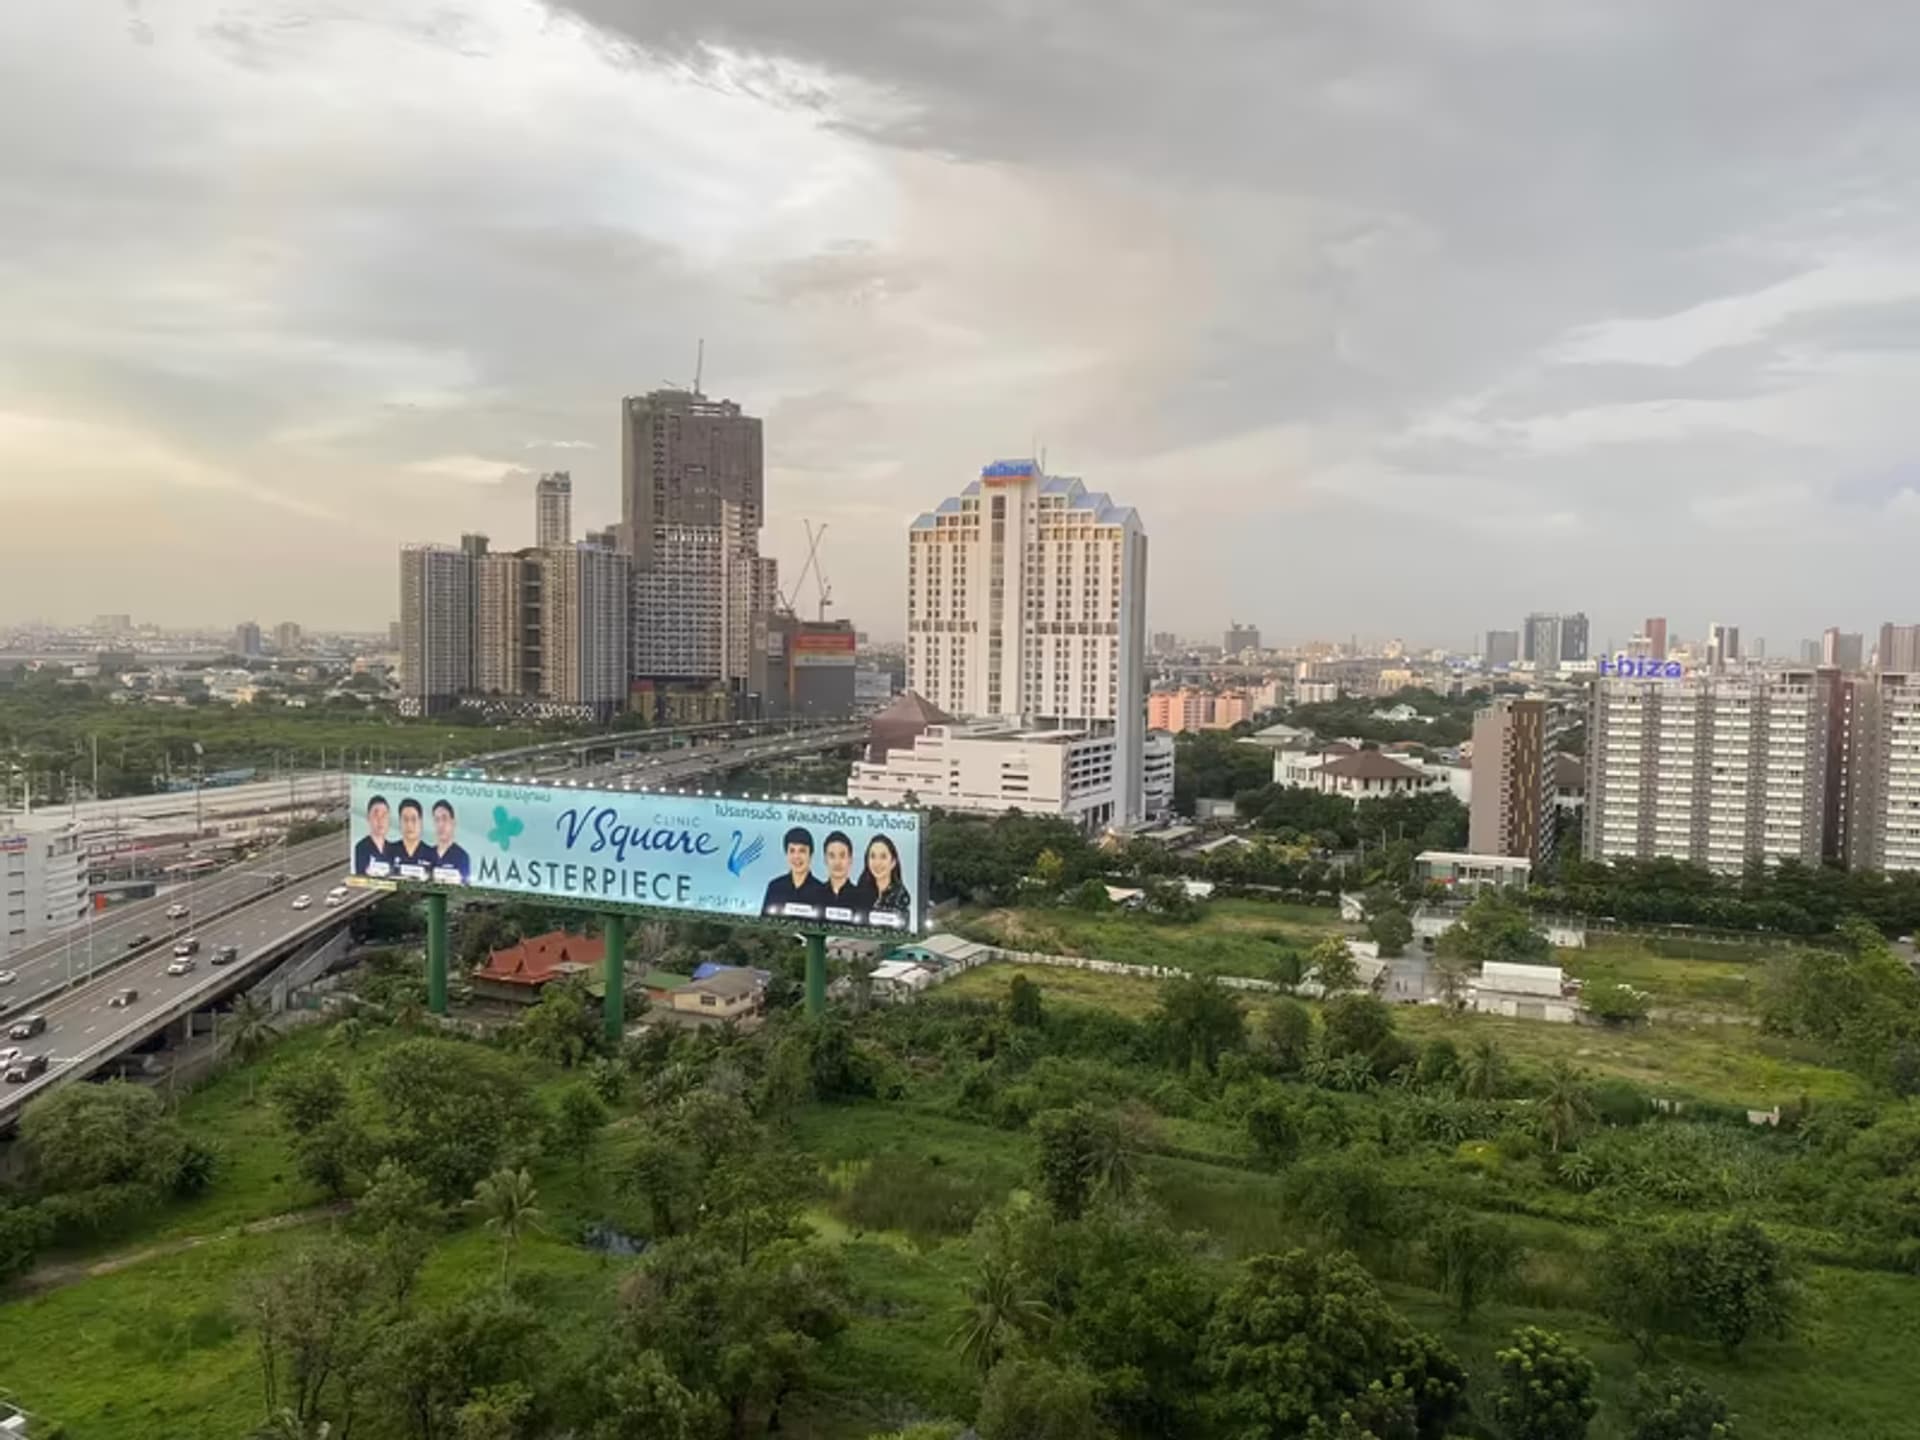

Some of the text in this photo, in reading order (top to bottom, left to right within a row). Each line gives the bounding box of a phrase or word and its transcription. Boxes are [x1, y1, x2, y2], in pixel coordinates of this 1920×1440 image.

[1600, 653, 1682, 678] i-biza
[653, 814, 701, 828] CLINIC
[477, 856, 693, 901] MASTERPIECE
